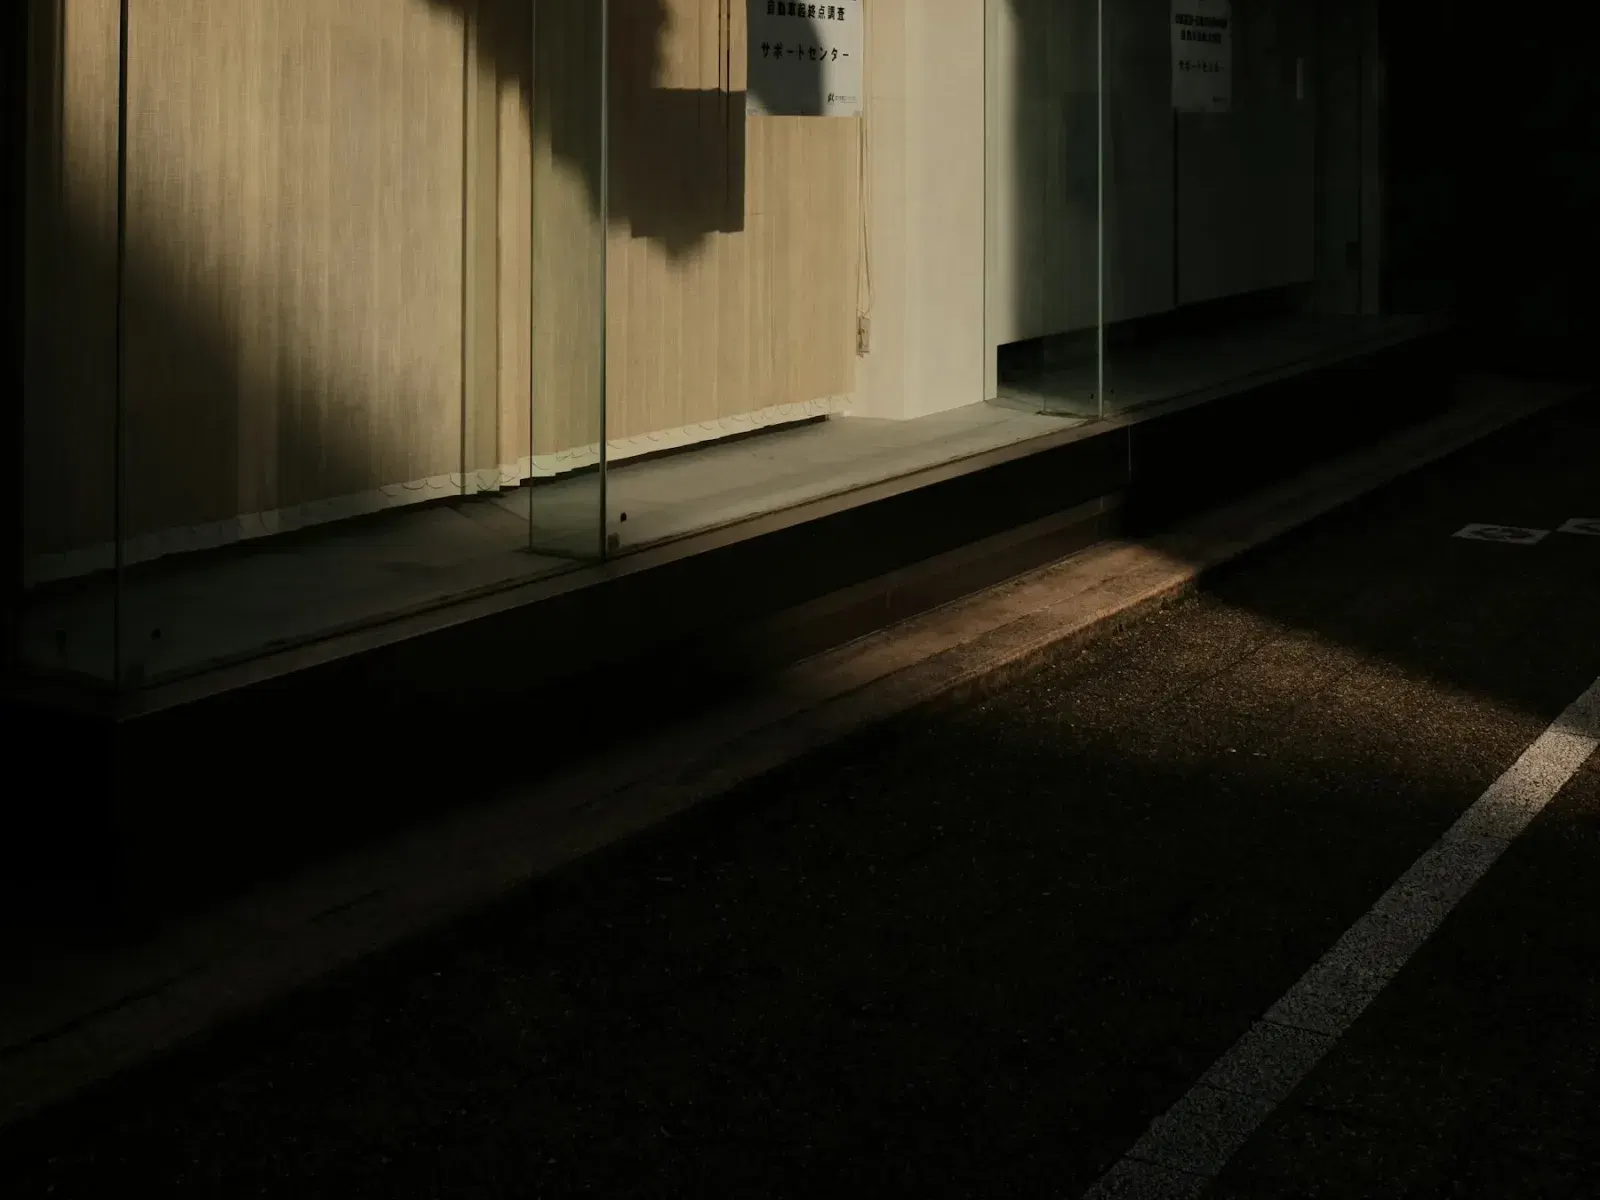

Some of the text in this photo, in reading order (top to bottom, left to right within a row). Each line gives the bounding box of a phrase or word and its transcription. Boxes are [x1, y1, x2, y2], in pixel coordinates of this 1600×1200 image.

[761, 41, 850, 62] サポートセンター
